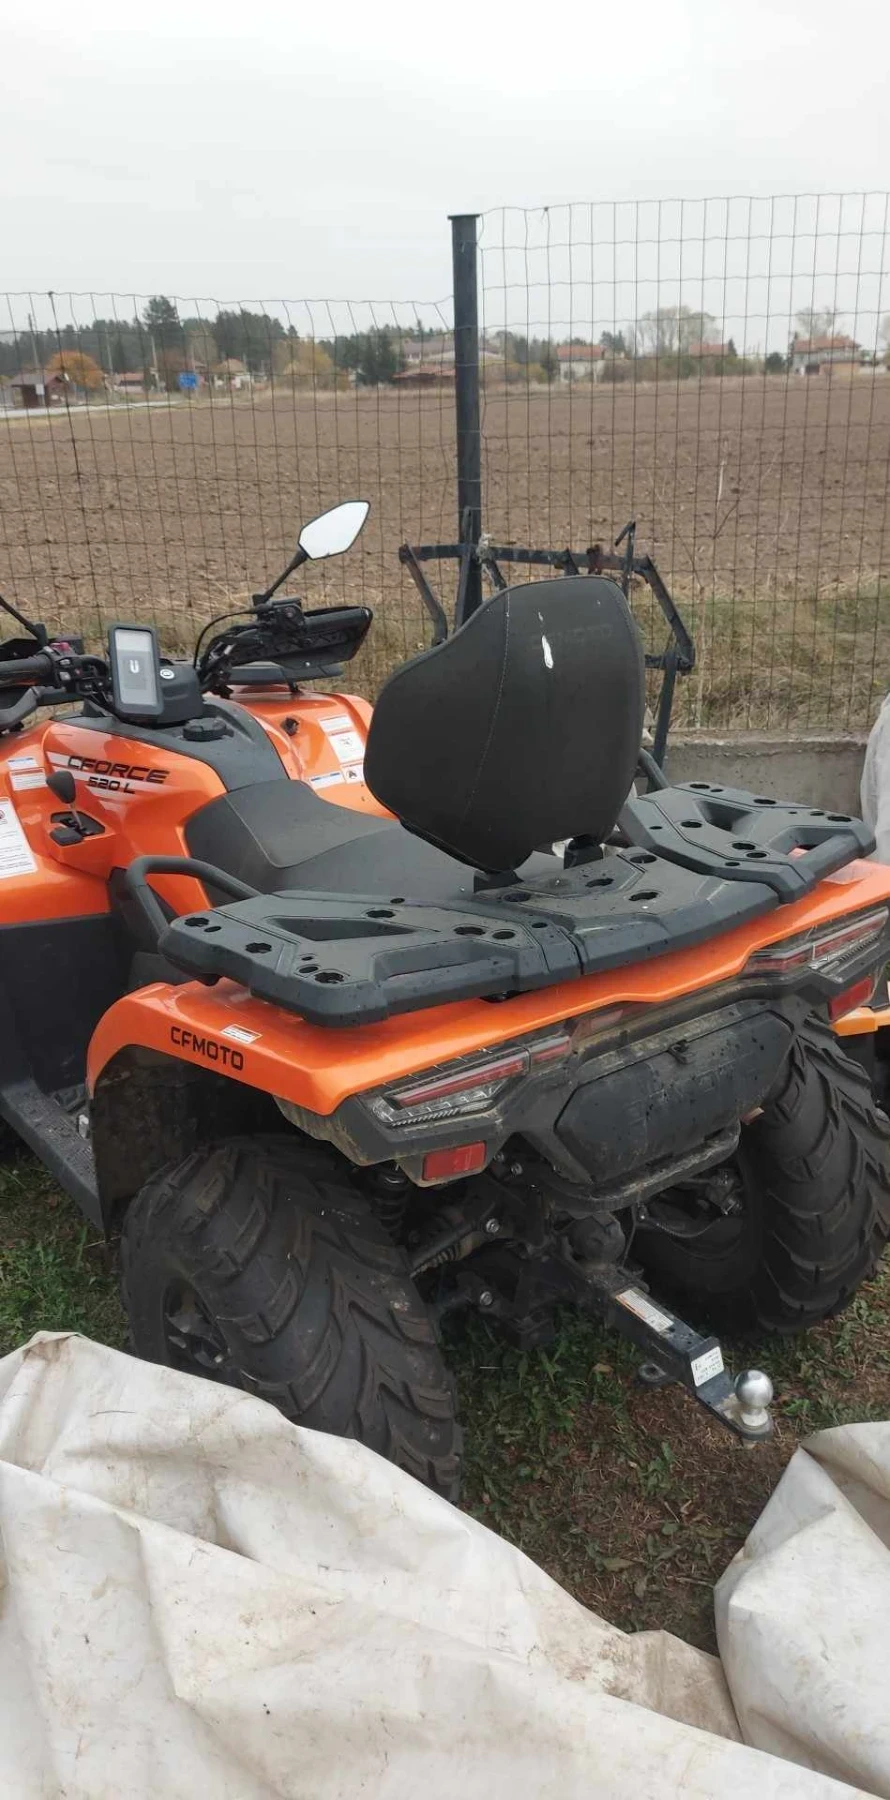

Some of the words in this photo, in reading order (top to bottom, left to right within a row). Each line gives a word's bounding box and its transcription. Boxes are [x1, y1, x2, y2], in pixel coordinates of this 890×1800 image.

[67, 755, 170, 784] CFORCE
[86, 776, 120, 791] 520
[123, 783, 135, 794] L
[171, 1026, 244, 1071] CFMOTO
